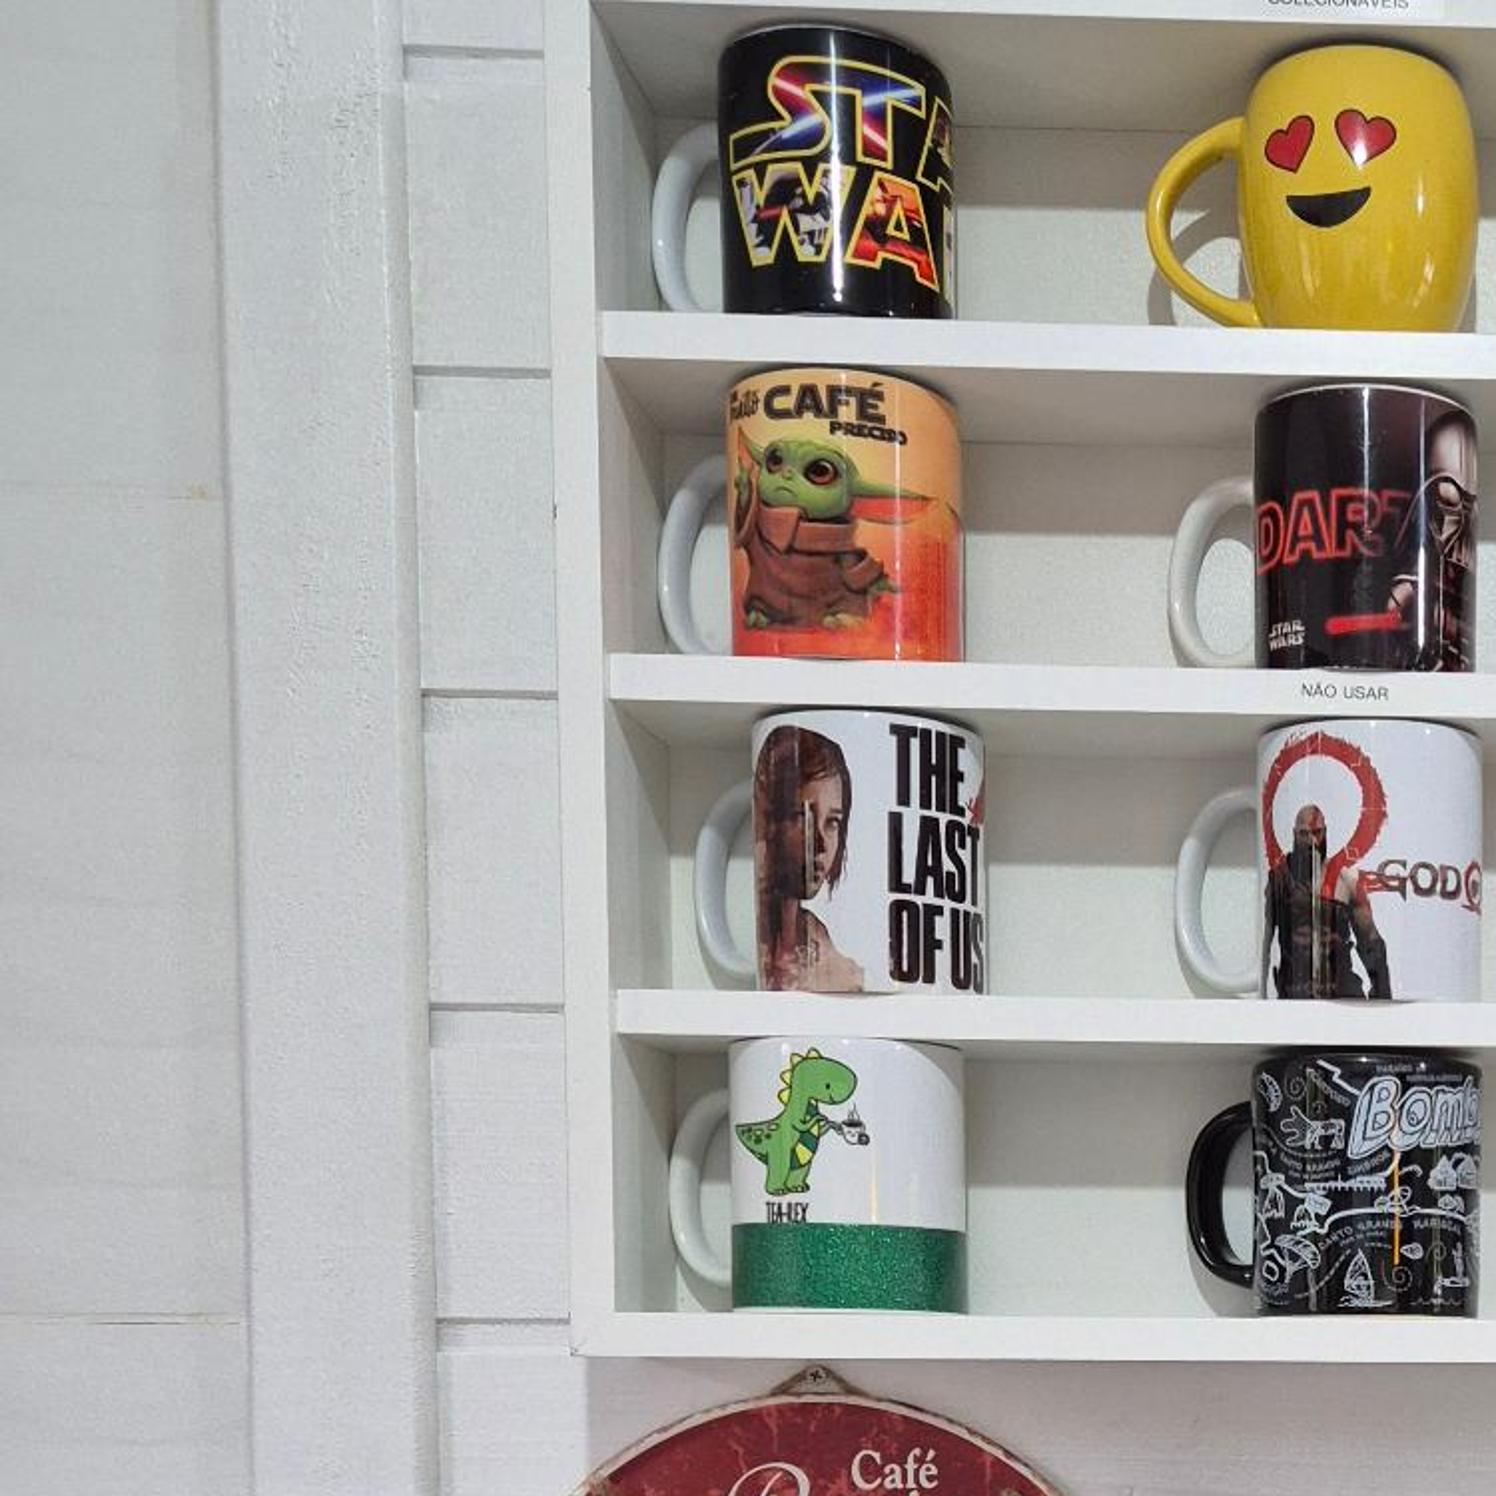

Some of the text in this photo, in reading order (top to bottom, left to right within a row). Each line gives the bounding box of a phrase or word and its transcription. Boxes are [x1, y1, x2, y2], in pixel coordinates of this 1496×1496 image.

[731, 160, 956, 298] WA
[763, 382, 886, 426] CAFÉ
[1269, 620, 1305, 637] STAR
[1343, 685, 1389, 700] USAR
[889, 723, 966, 818] THE
[888, 811, 980, 907] LAST
[888, 899, 985, 995] OF US
[851, 1447, 939, 1491] Café
